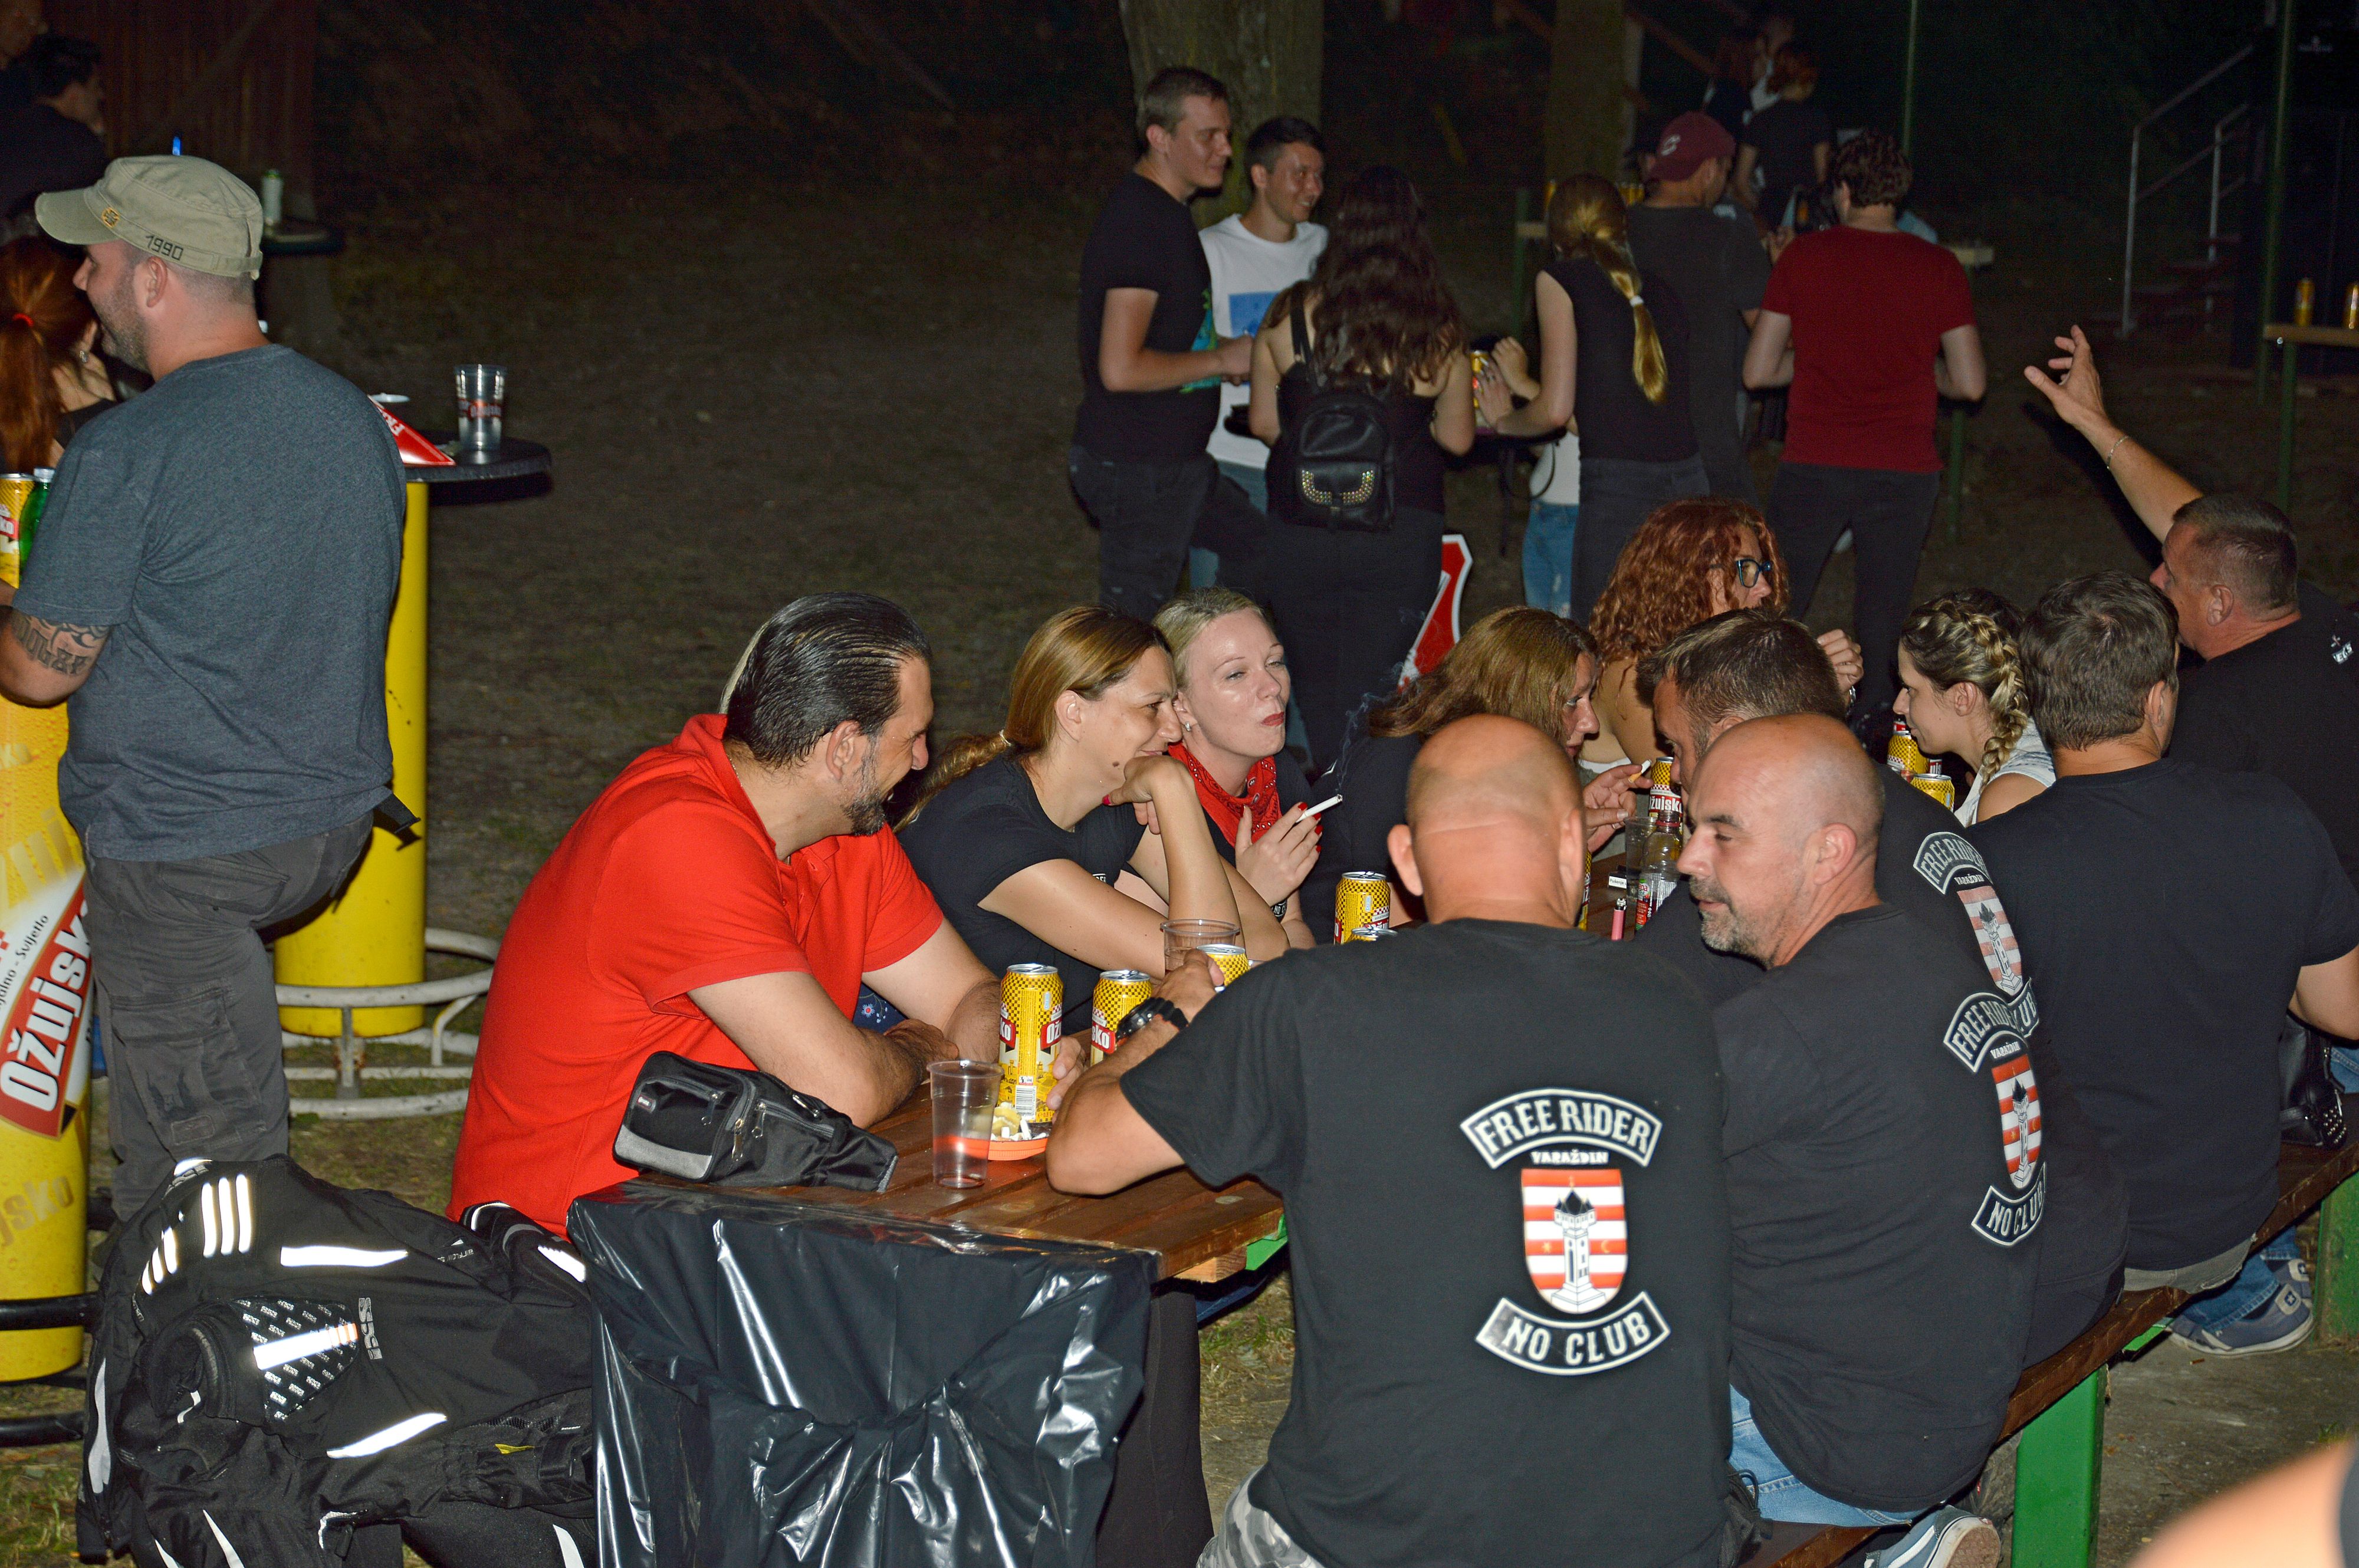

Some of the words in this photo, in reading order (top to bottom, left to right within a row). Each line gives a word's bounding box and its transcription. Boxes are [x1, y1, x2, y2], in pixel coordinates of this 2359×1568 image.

[146, 235, 183, 261] 1990
[1921, 840, 1953, 885] FREE
[15, 915, 49, 960] Svijetlo
[0, 900, 89, 1112] Ožujsk
[1951, 1005, 1991, 1060] FREE
[1475, 1100, 1557, 1155] FREE
[1559, 1100, 1651, 1154] RIDER
[1530, 1149, 1609, 1165] VARAŽDIN
[1986, 1201, 2012, 1236] NO
[2013, 1181, 2043, 1235] CLUB
[1502, 1316, 1551, 1362] NO
[1565, 1312, 1652, 1366] CLUB
